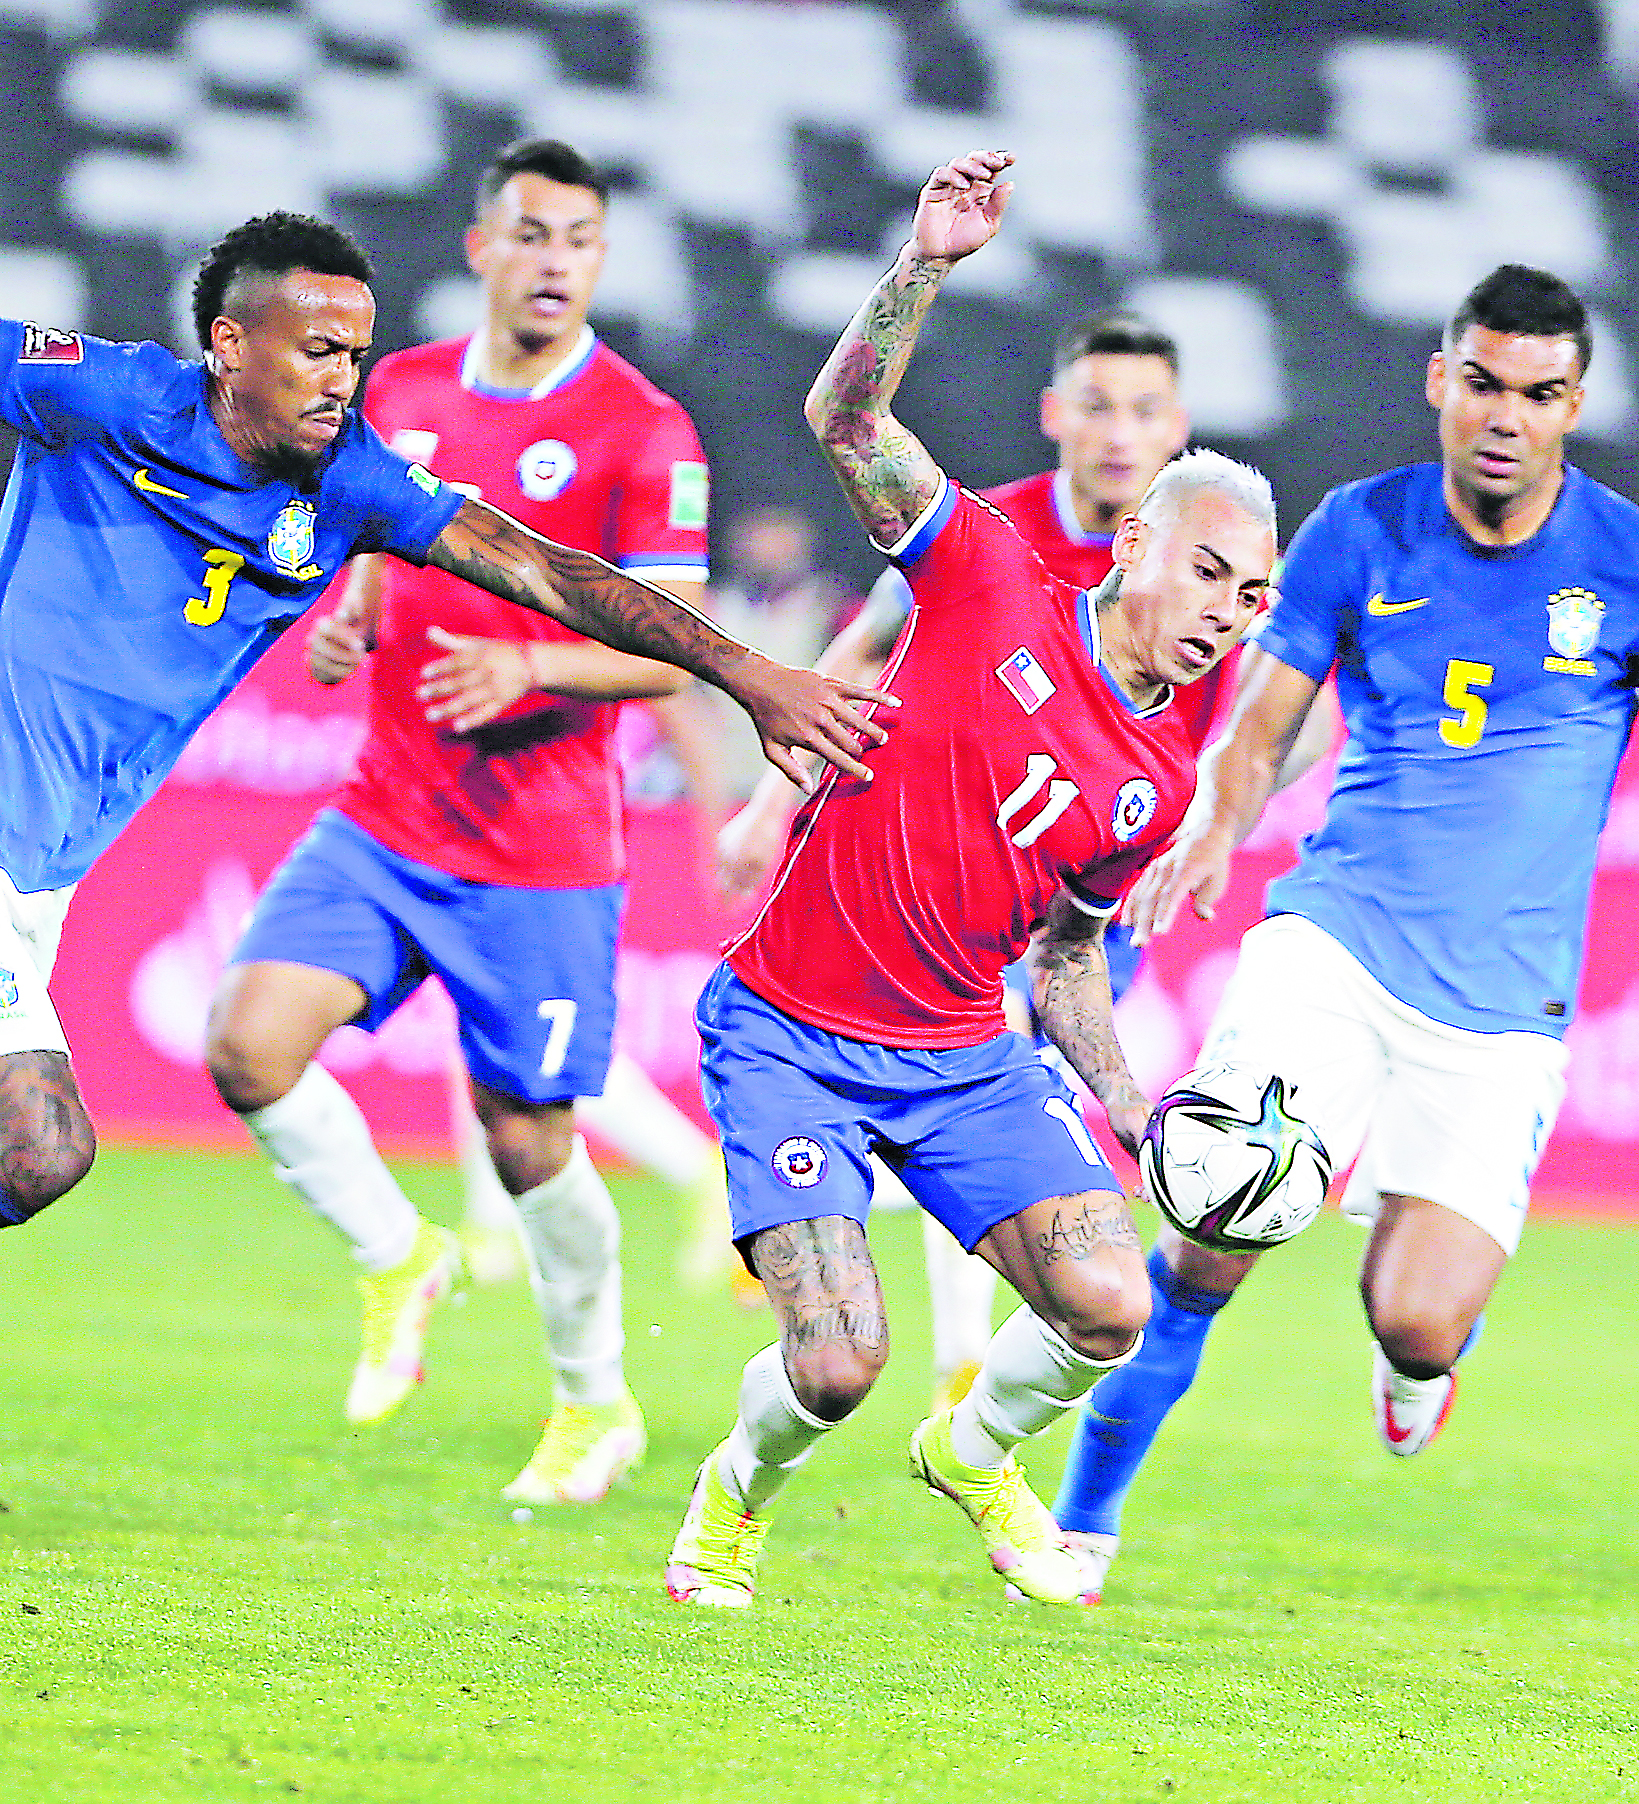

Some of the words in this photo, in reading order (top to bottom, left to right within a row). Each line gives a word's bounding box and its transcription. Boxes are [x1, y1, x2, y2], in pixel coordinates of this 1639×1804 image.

[182, 548, 246, 627] 3
[1438, 659, 1495, 749] 5
[996, 753, 1081, 849] 11
[538, 999, 577, 1078] 7
[1042, 1093, 1103, 1166] 1
